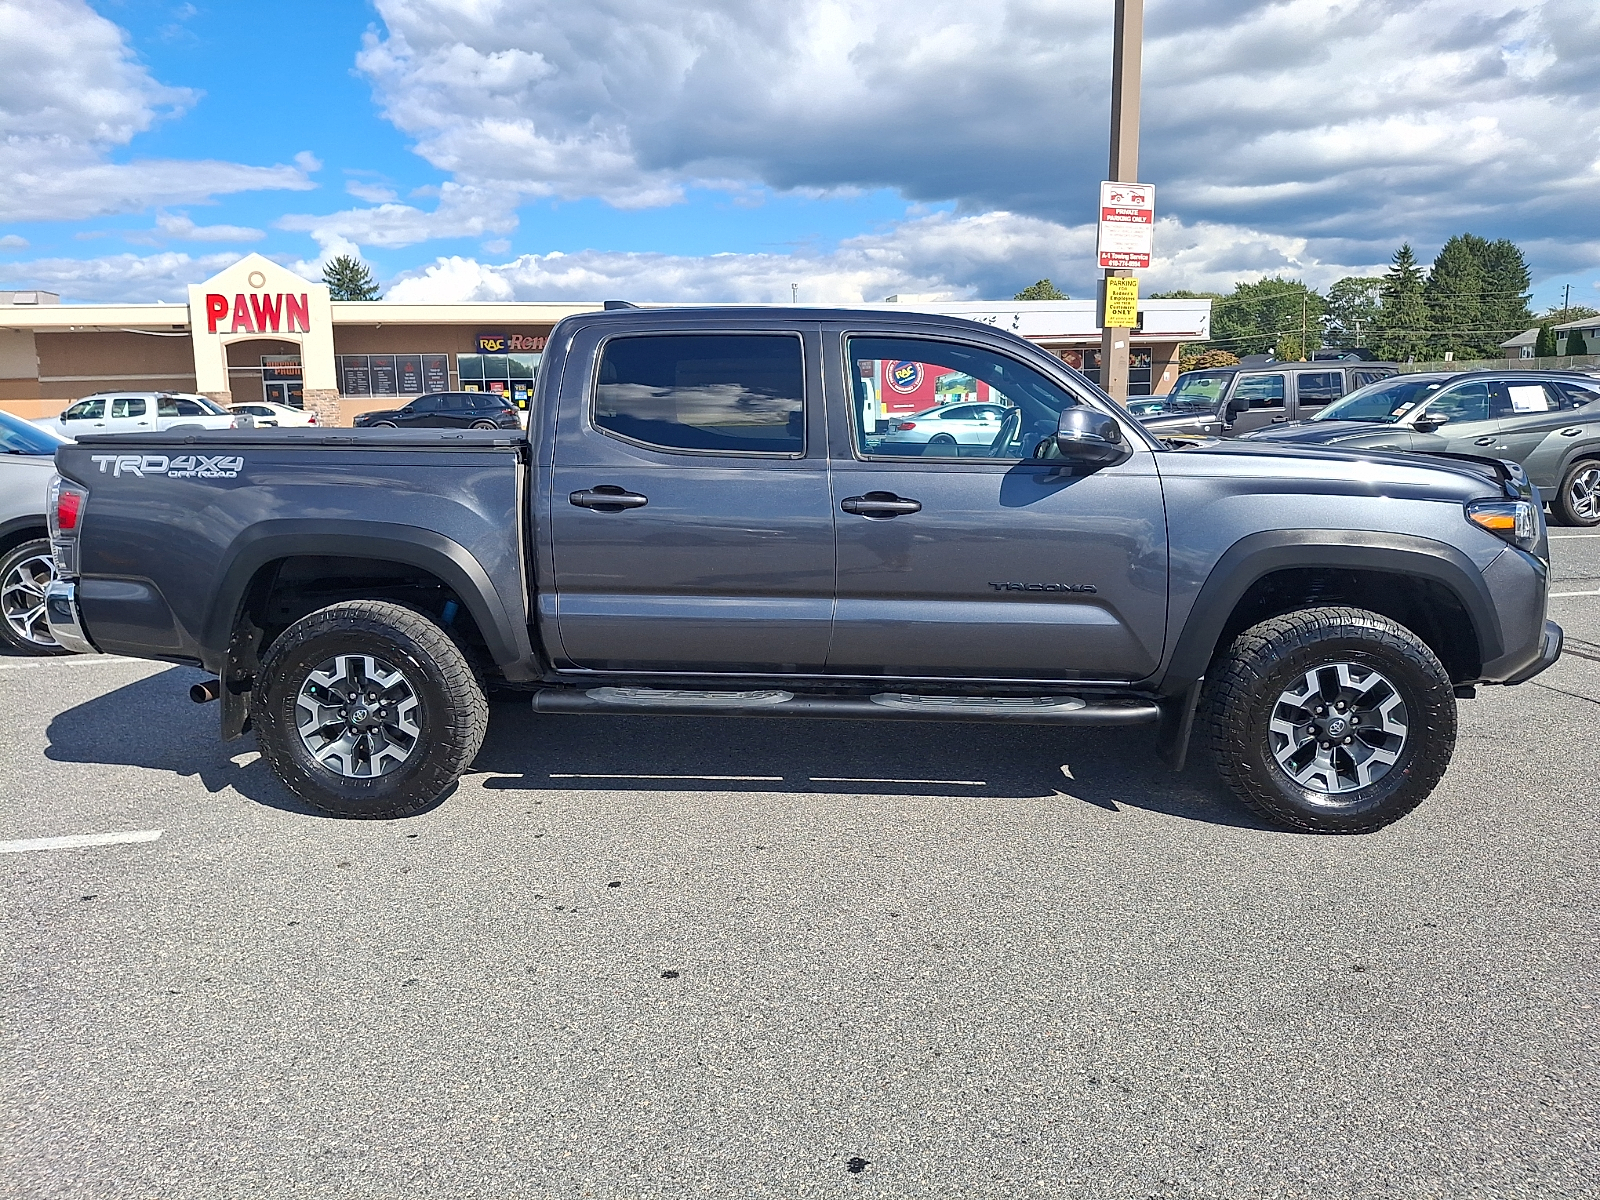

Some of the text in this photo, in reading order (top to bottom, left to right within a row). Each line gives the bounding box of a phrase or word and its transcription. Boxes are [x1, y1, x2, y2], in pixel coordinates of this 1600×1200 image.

[206, 293, 310, 334] PAWN
[480, 340, 504, 351] RAC
[895, 366, 914, 379] RAC
[91, 455, 169, 478] TRD
[988, 582, 1097, 593] TACOMA
